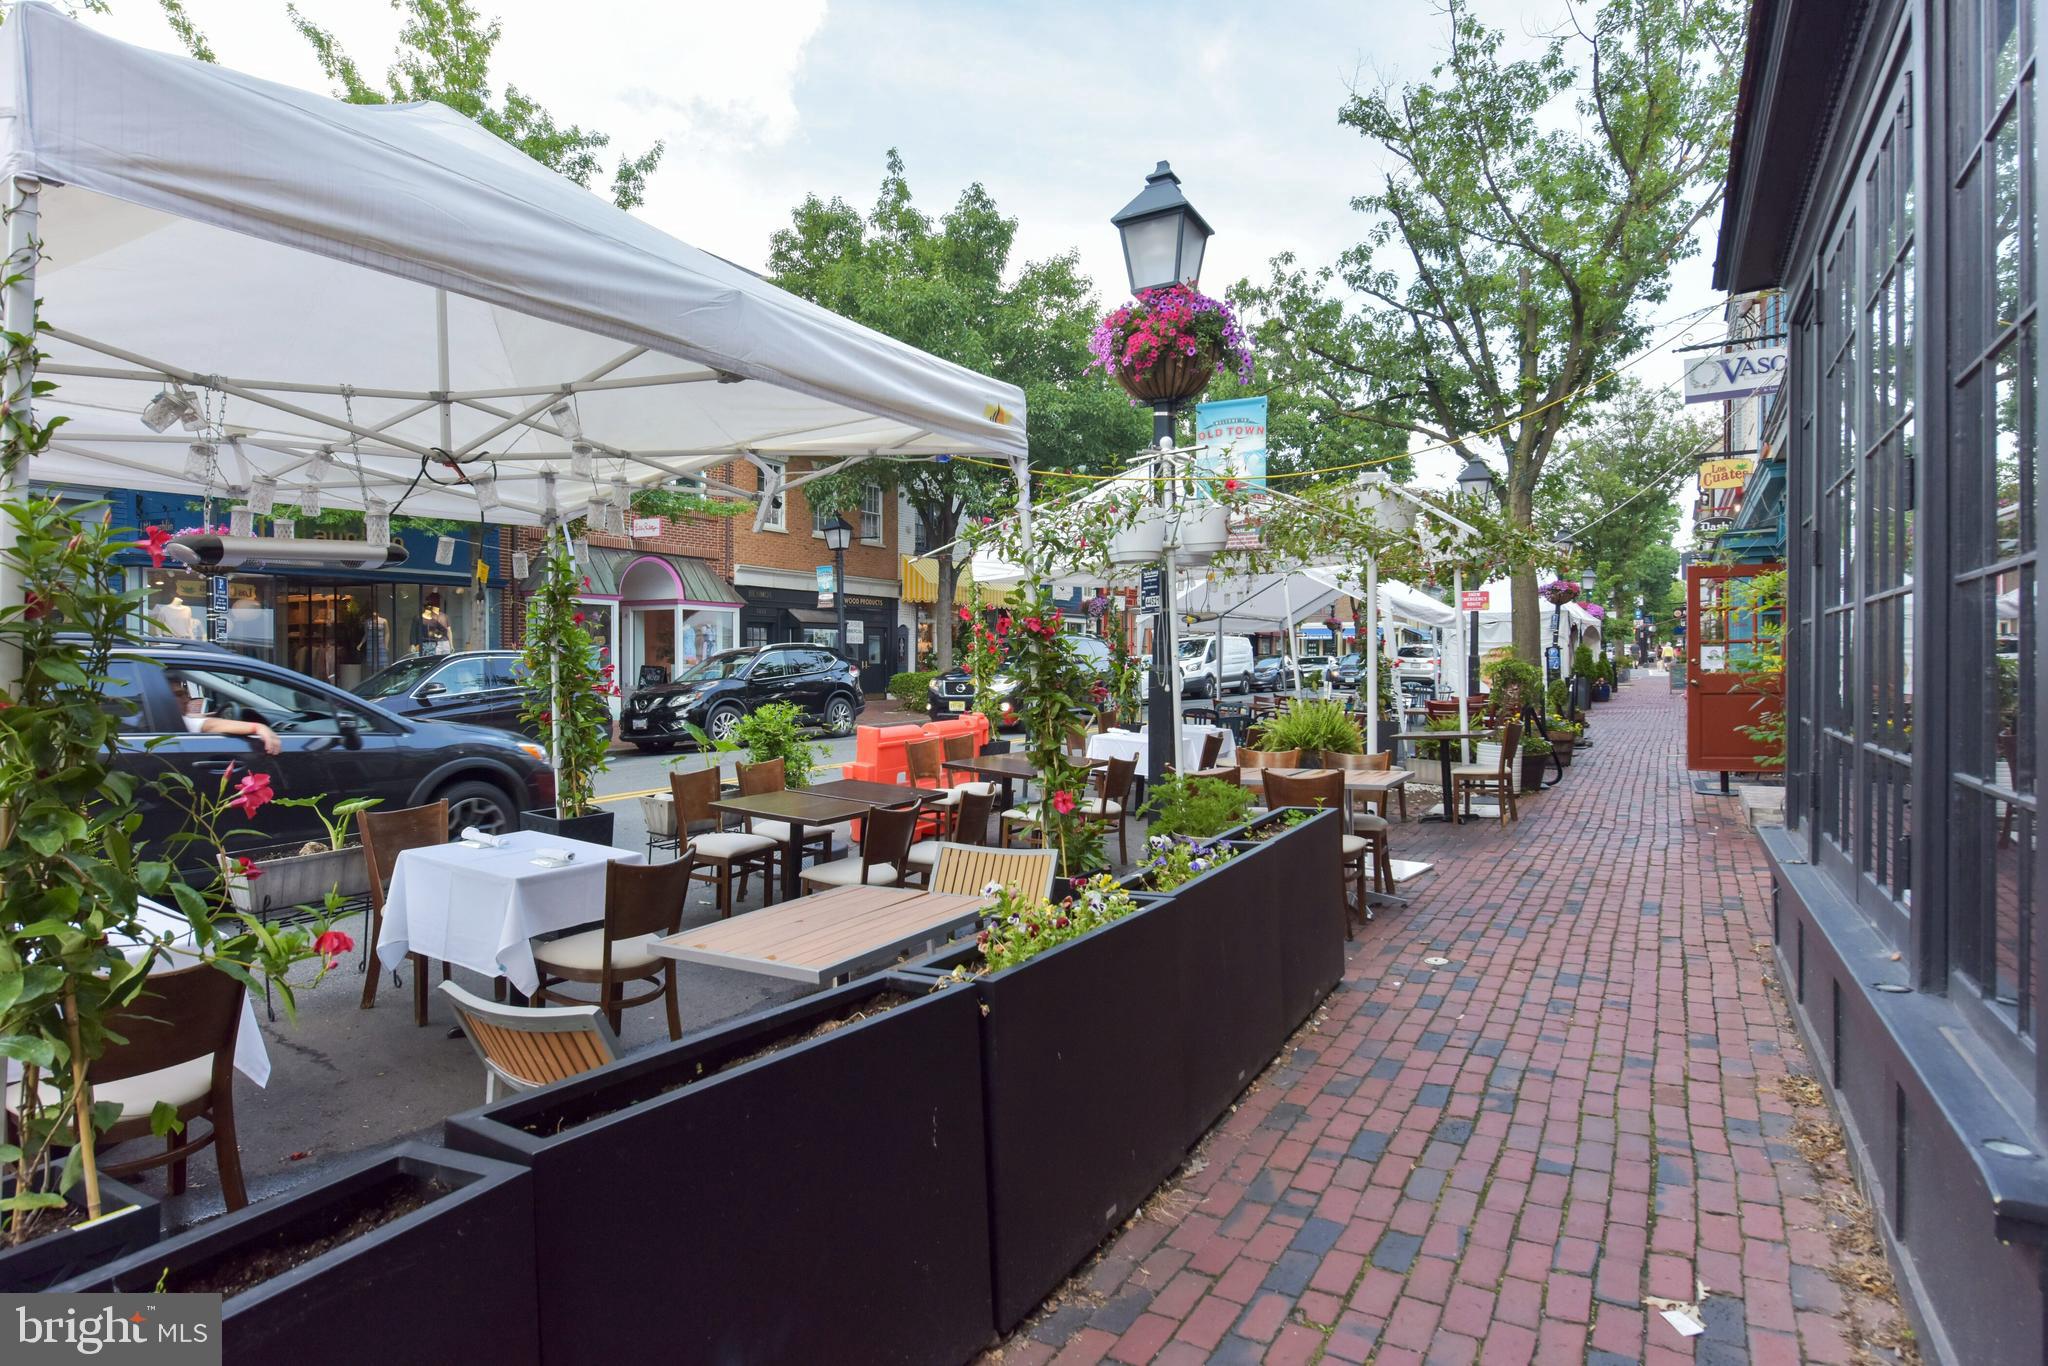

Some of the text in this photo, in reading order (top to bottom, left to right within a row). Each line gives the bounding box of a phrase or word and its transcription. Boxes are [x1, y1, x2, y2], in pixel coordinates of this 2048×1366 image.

[1198, 425, 1265, 441] OLD TOWN
[1711, 464, 1727, 473] Los
[860, 598, 883, 606] PRODUCTS
